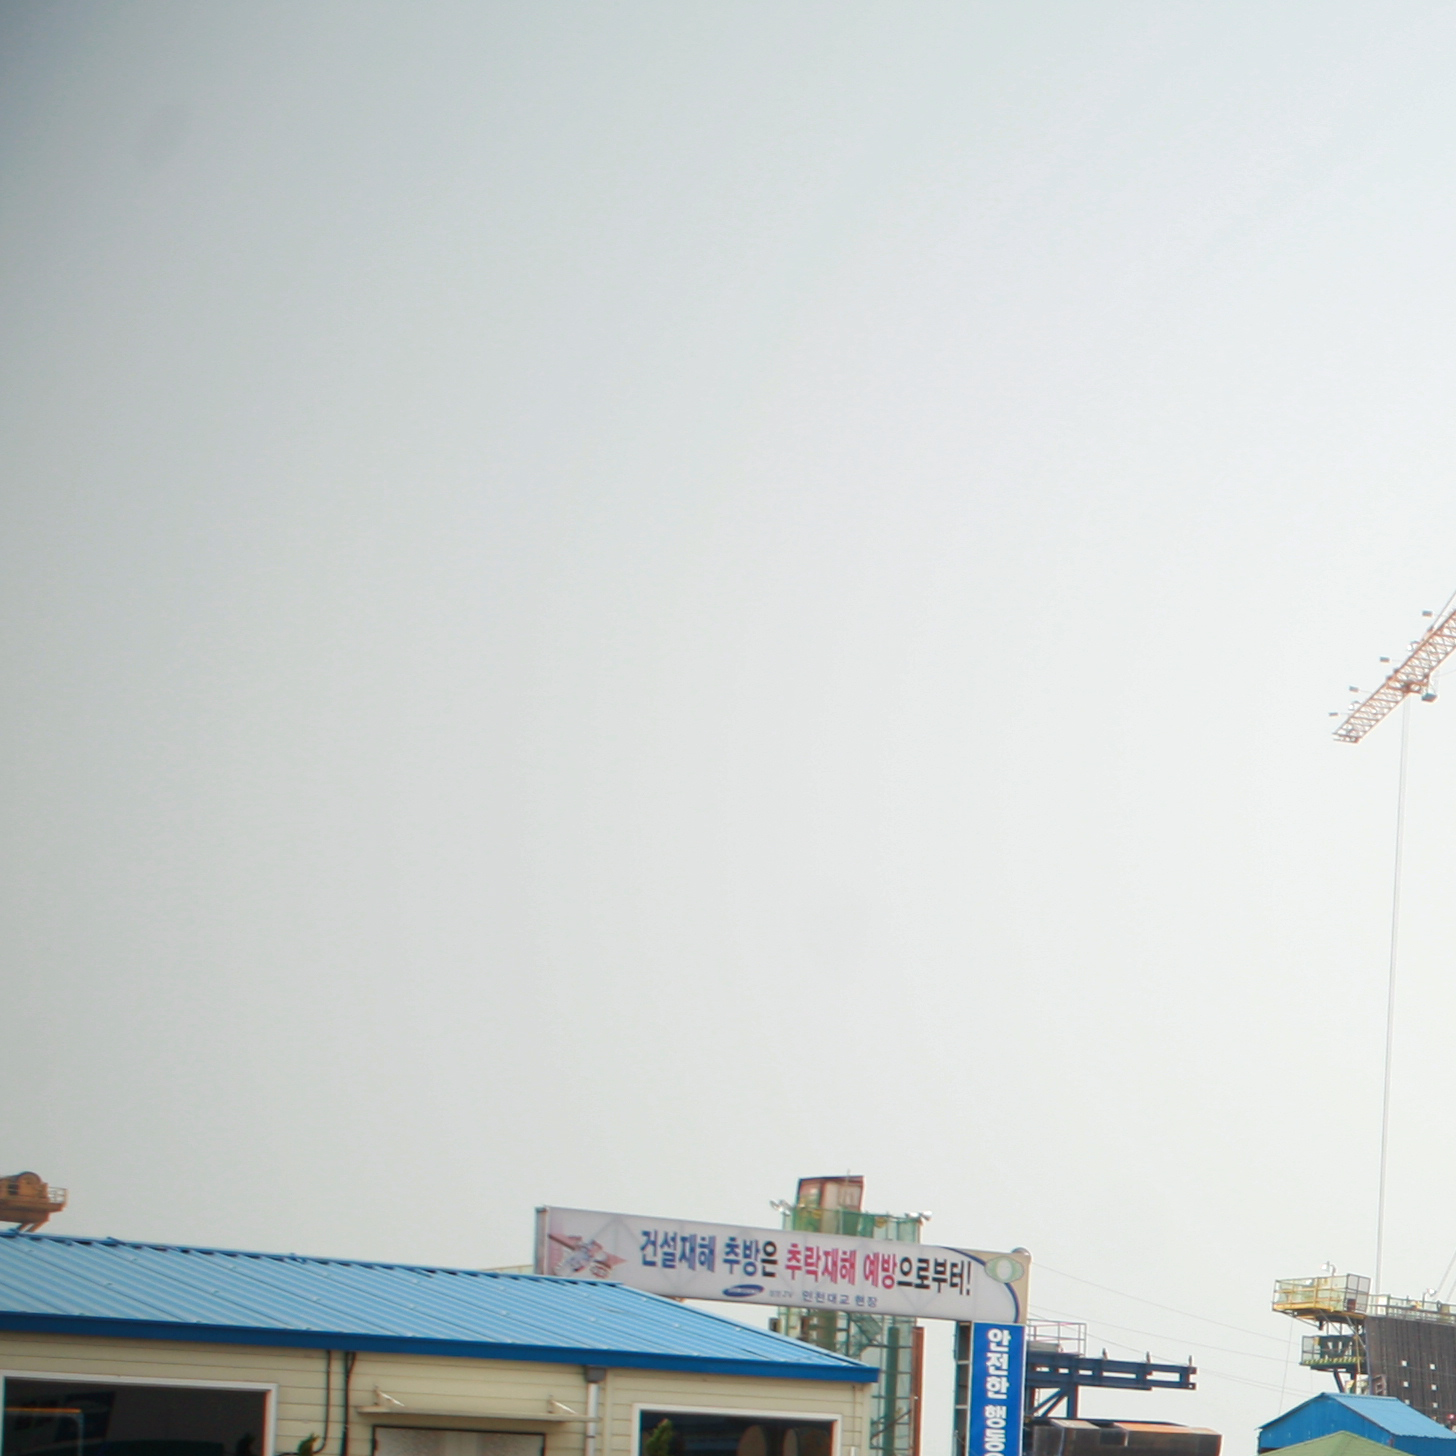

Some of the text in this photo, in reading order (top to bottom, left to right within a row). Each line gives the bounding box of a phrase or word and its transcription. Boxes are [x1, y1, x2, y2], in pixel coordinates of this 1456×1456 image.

[640, 1229, 973, 1297] 건설재해 추방은 추락재해 예방으로부터!
[801, 1290, 850, 1305] 인천대교
[985, 1328, 1011, 1399] 안전한
